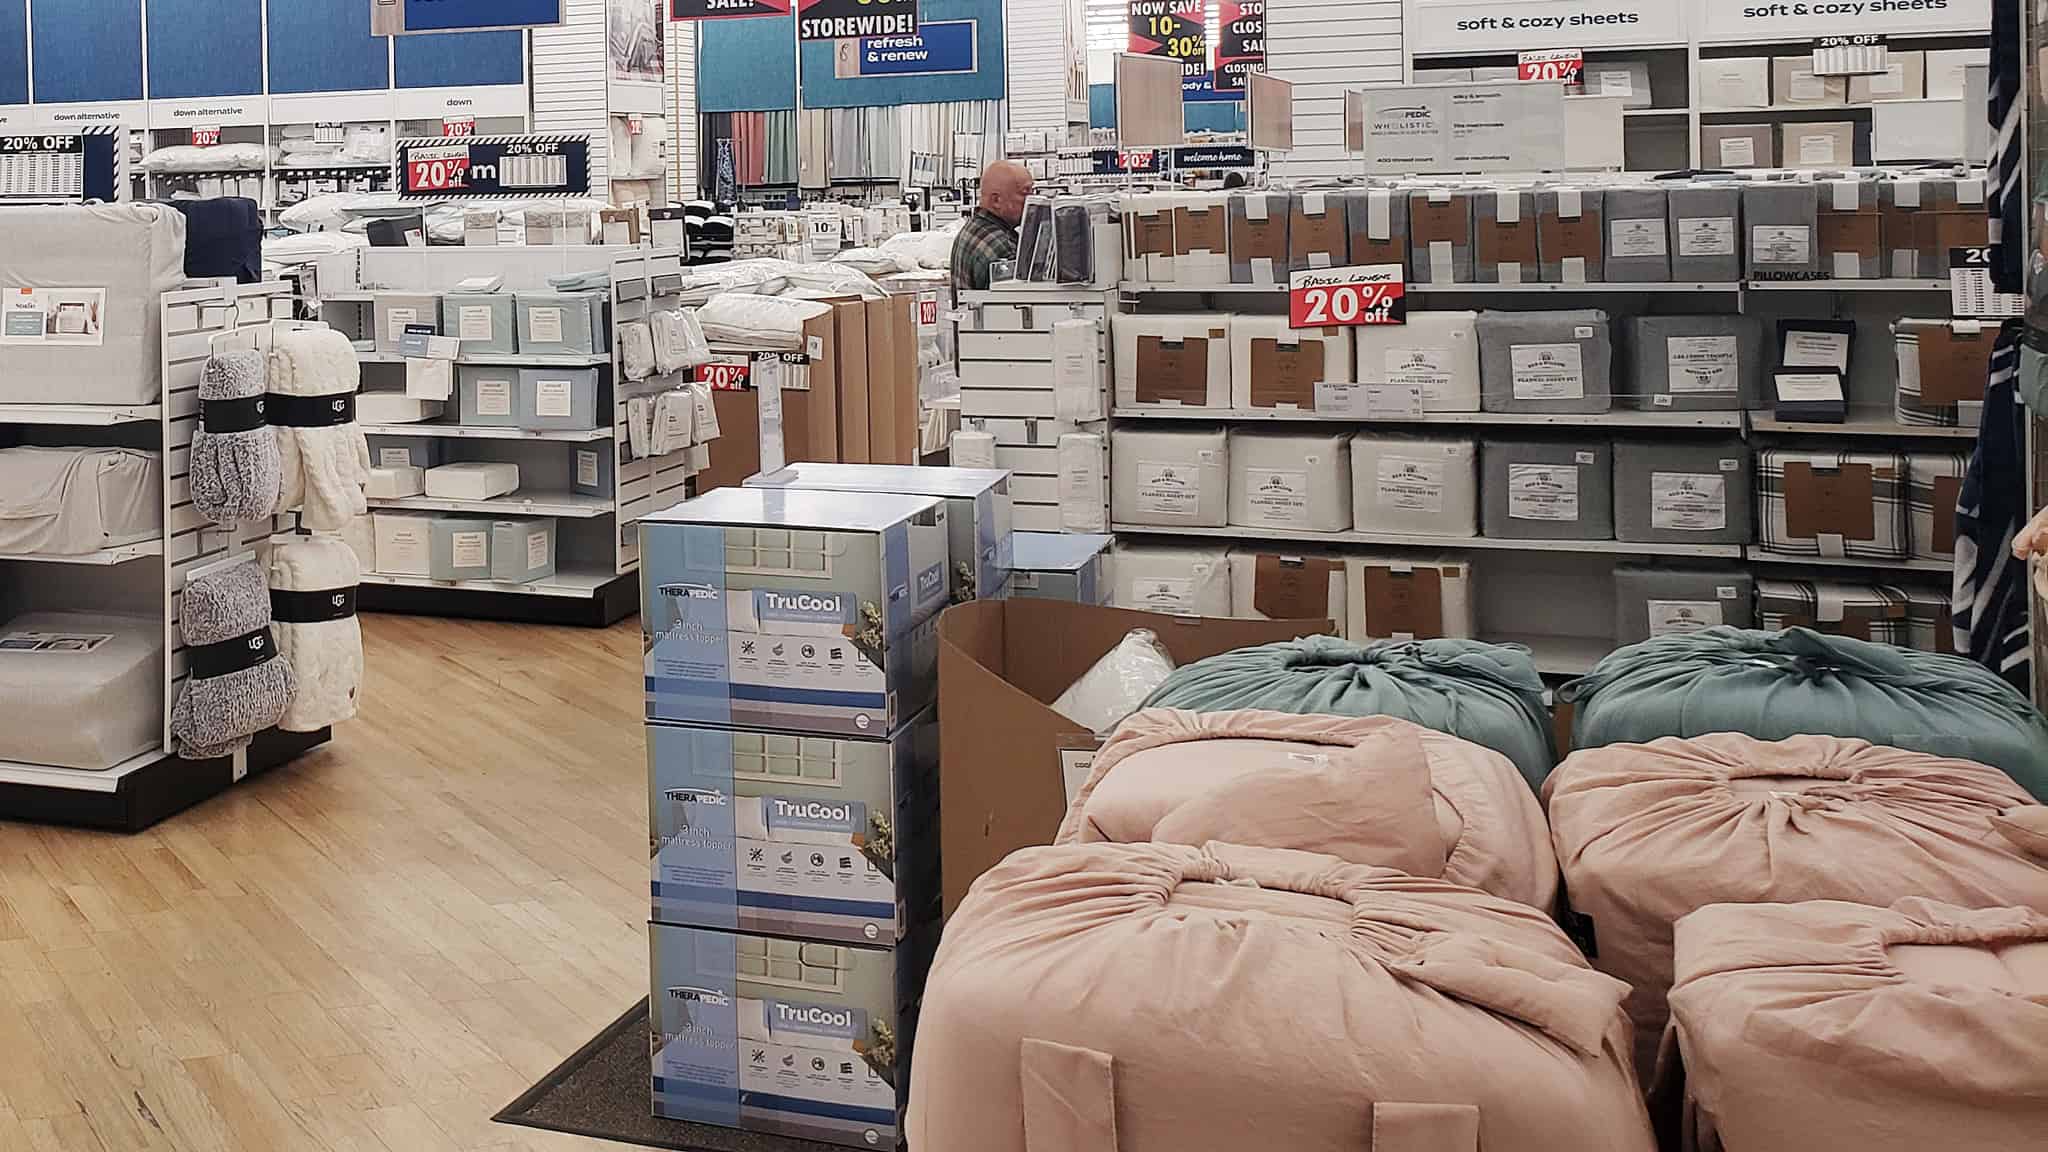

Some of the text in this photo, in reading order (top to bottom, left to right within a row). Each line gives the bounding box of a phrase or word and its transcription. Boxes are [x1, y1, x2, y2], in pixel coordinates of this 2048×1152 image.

[1131, 0, 1201, 15] NOW SAVE
[1240, 3, 1263, 15] STO
[1744, 0, 1948, 17] soft & cozy sheets
[801, 14, 914, 38] STOREWIDE!
[1148, 16, 1181, 36] 10-
[1232, 21, 1263, 33] CLOS
[1457, 11, 1639, 30] soft & cozy sheets
[867, 35, 923, 49] refresh
[1168, 35, 1205, 57] 30%
[1242, 40, 1264, 52] SAL
[1821, 35, 1879, 46] 20% OFF
[867, 49, 928, 62] & renew
[1225, 63, 1264, 73] CLOSING
[1527, 61, 1577, 80] 20%
[1182, 81, 1202, 90] ody
[1231, 77, 1247, 86] SA
[446, 98, 472, 106] down
[54, 111, 120, 121] down alternative
[174, 106, 243, 117] down alternative
[447, 123, 471, 136] 20%
[3, 136, 74, 150] 20% OFF
[195, 131, 219, 145] 20%
[506, 143, 559, 154] 20% OFF
[1183, 151, 1243, 162] welcome home
[416, 160, 465, 187] 20%
[470, 162, 496, 179] m
[448, 176, 462, 187] off
[1966, 248, 1991, 263] 20
[1753, 272, 1830, 281] PILLOWCASES
[1304, 285, 1393, 323] 20%
[1365, 308, 1389, 323] off
[783, 353, 804, 363] OFF
[704, 366, 744, 388] 20%
[332, 399, 345, 412] UGG
[659, 587, 719, 599] THERAPEDIC
[332, 594, 345, 607] UGG
[766, 592, 841, 612] TruCool
[248, 635, 264, 650] UGG
[665, 791, 726, 805] THERAPEDIC
[775, 800, 849, 821] TruCool
[669, 989, 729, 1006] THERAPEDIC
[776, 1003, 851, 1027] TruCool
